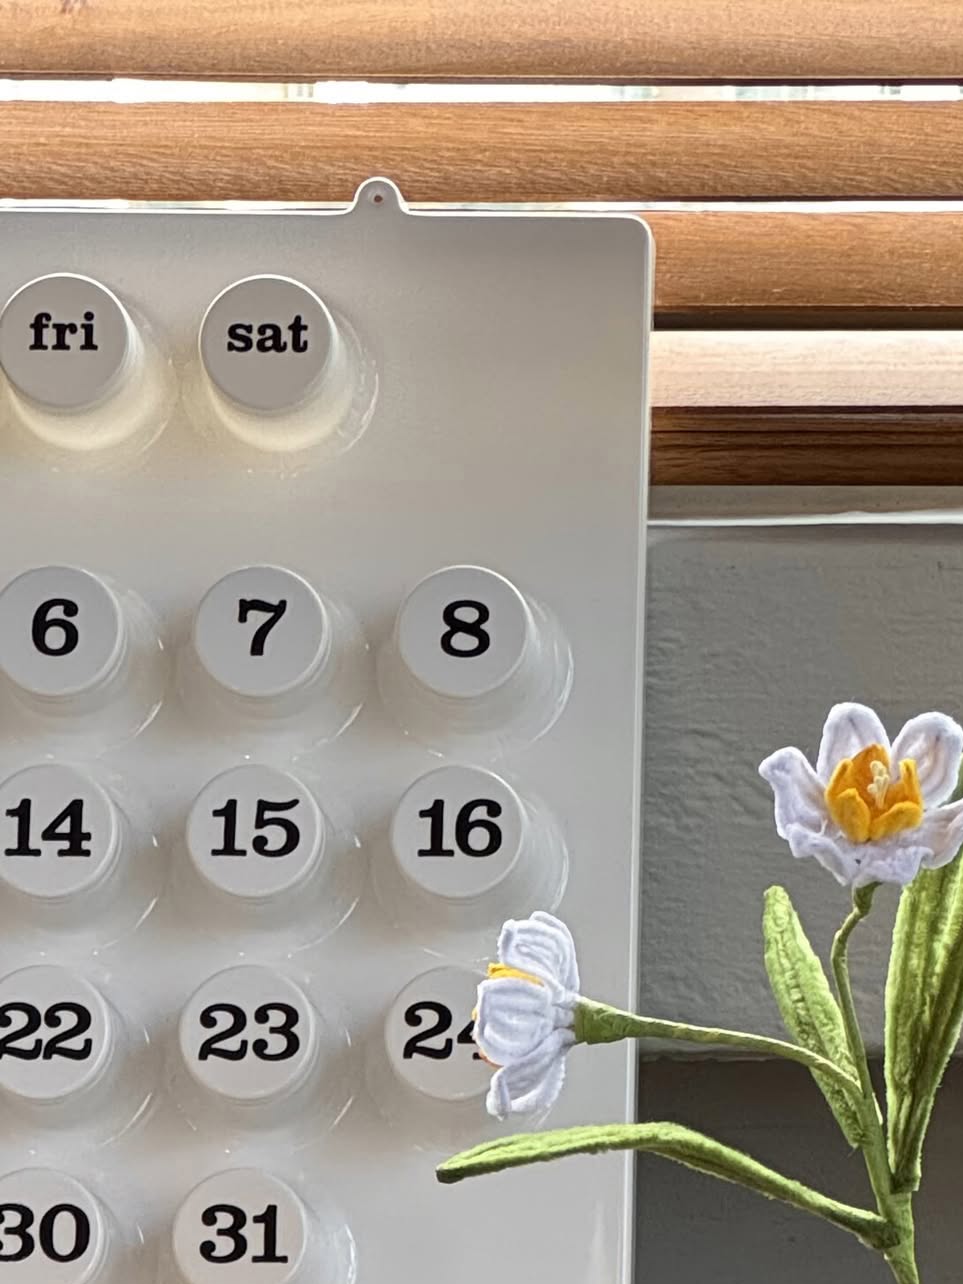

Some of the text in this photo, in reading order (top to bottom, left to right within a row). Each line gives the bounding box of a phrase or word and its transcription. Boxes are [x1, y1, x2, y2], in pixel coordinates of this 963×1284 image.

[28, 311, 309, 354] fri sat
[31, 598, 491, 658] 6 7 8
[4, 798, 503, 858] 14 15 16
[0, 1001, 93, 1061] 22
[198, 1002, 300, 1062] 23
[0, 1203, 289, 1264] 30 31
